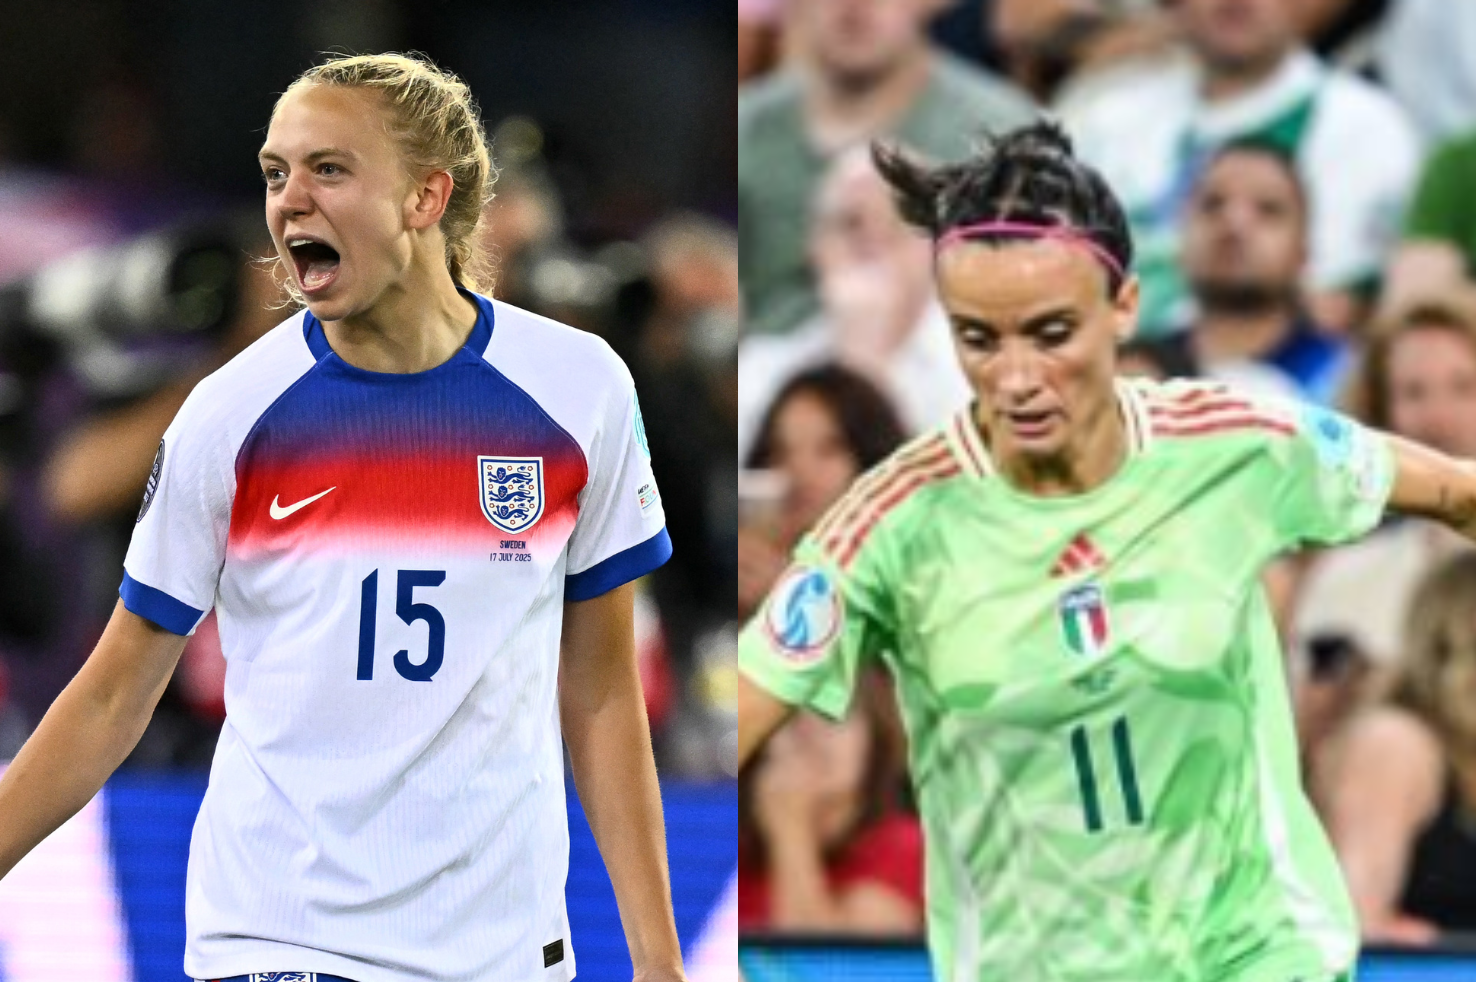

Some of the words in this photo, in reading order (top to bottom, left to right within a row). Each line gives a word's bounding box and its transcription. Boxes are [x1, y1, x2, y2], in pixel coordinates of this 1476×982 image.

[490, 553, 497, 561] 17
[499, 553, 513, 561] JULY
[515, 553, 532, 562] 2025
[500, 540, 526, 549] SWEDEN
[357, 568, 446, 682] 15
[1071, 714, 1144, 833] 11
